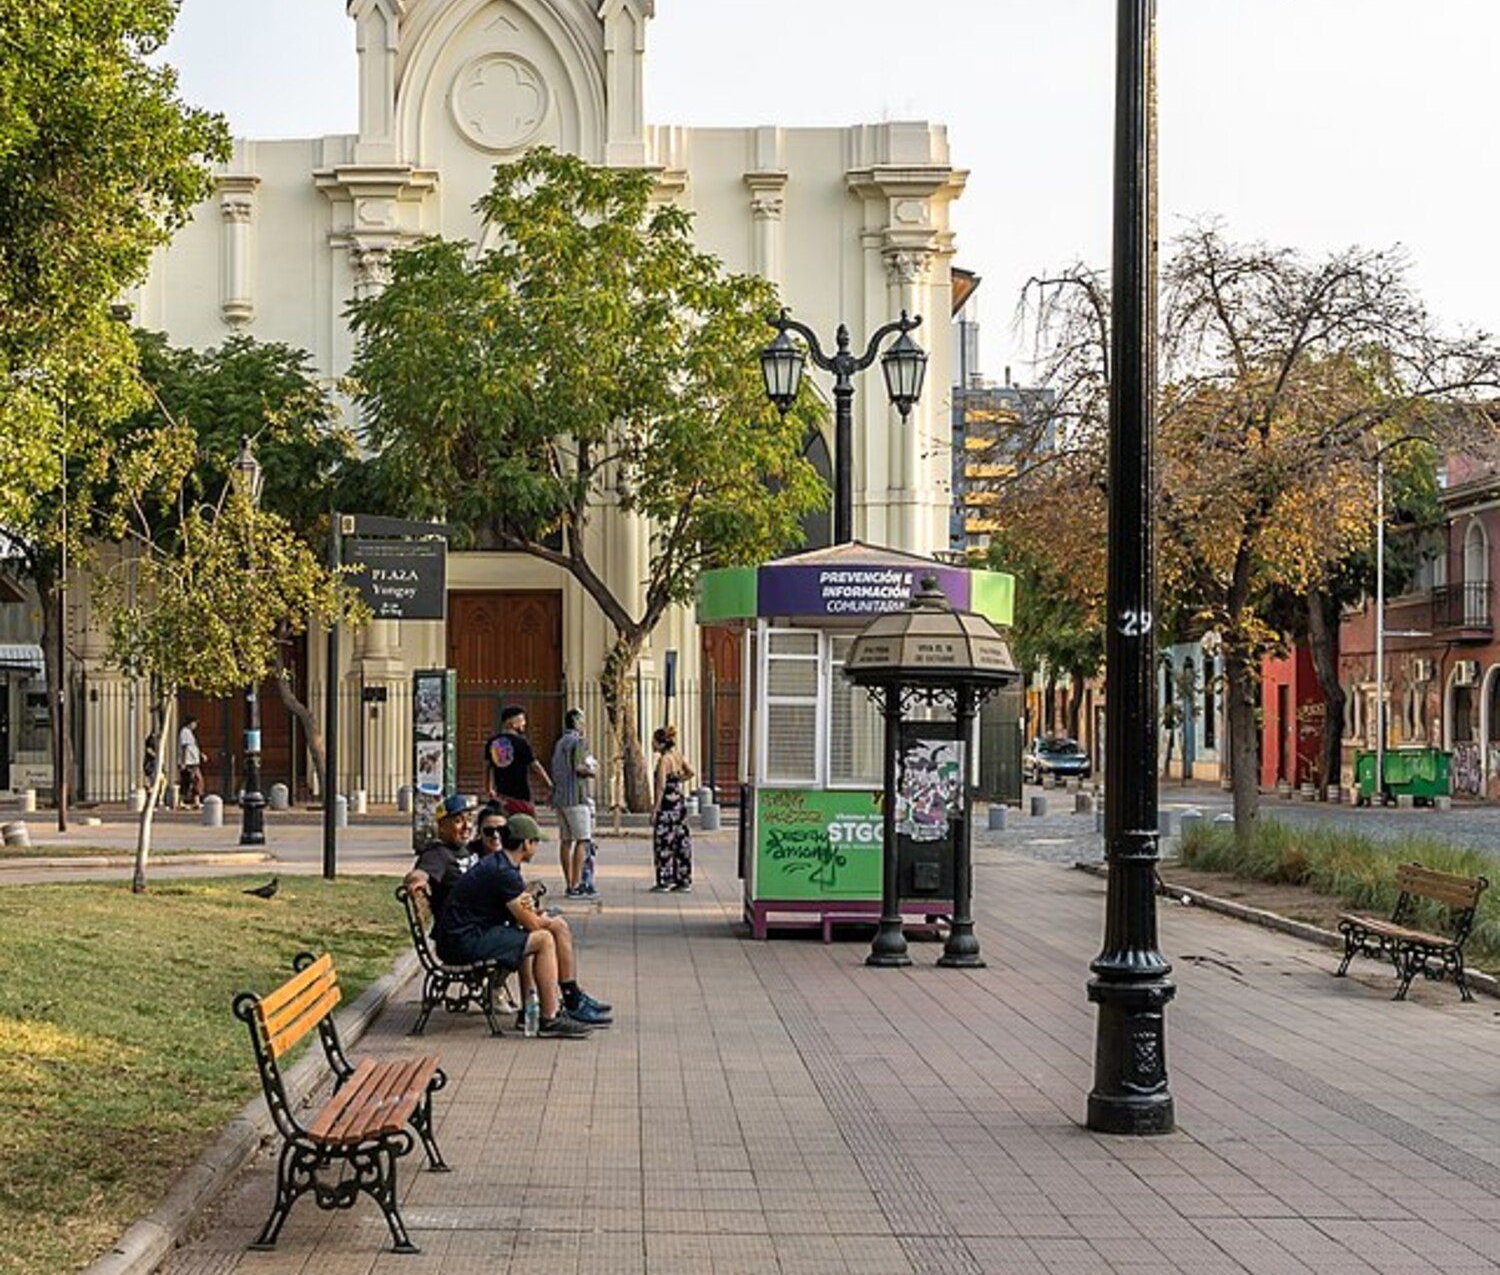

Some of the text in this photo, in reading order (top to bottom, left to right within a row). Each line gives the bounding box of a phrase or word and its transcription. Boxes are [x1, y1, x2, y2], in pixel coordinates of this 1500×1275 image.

[371, 569, 419, 581] PLAZA
[820, 570, 913, 585] PREVENCIÓN E
[822, 584, 911, 599] INFORMACIÓN
